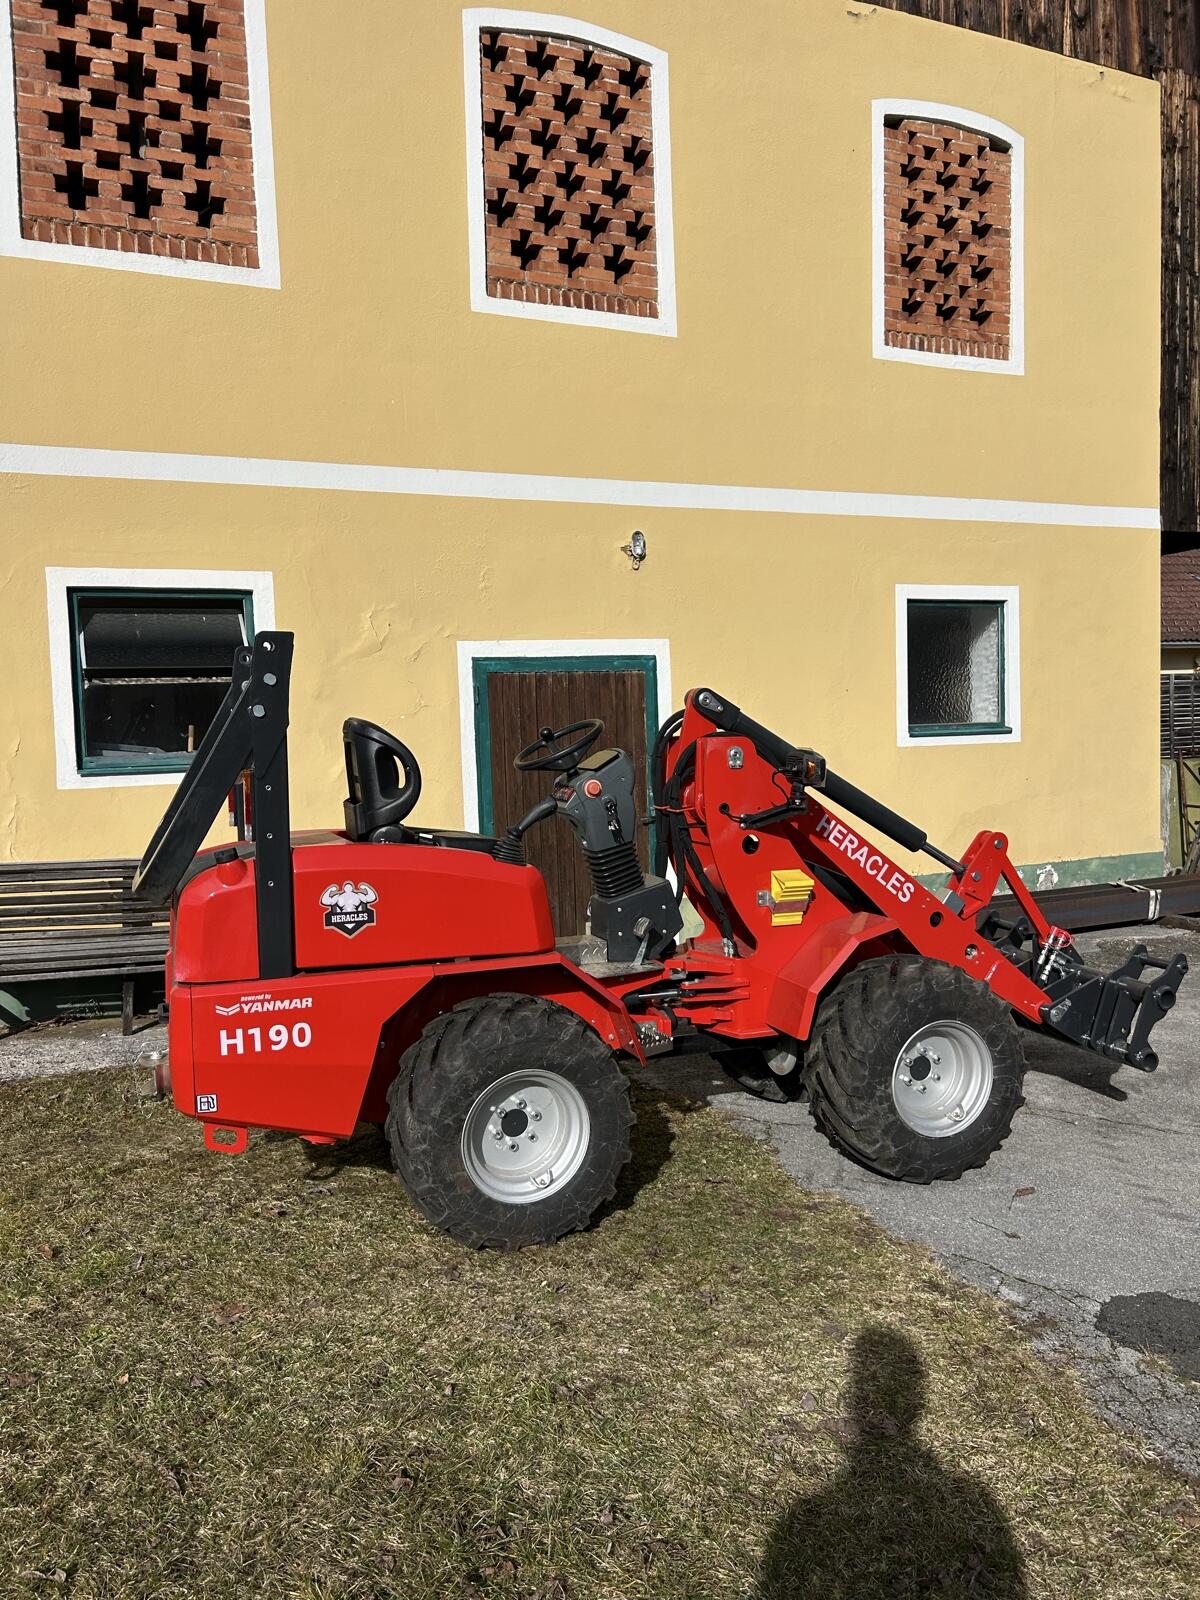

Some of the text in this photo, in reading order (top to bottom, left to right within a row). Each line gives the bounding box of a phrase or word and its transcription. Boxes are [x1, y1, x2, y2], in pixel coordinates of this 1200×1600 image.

[815, 814, 915, 903] HERACLES
[331, 913, 368, 923] HERACLES
[240, 997, 313, 1014] YANMAR
[219, 1022, 312, 1056] H190
